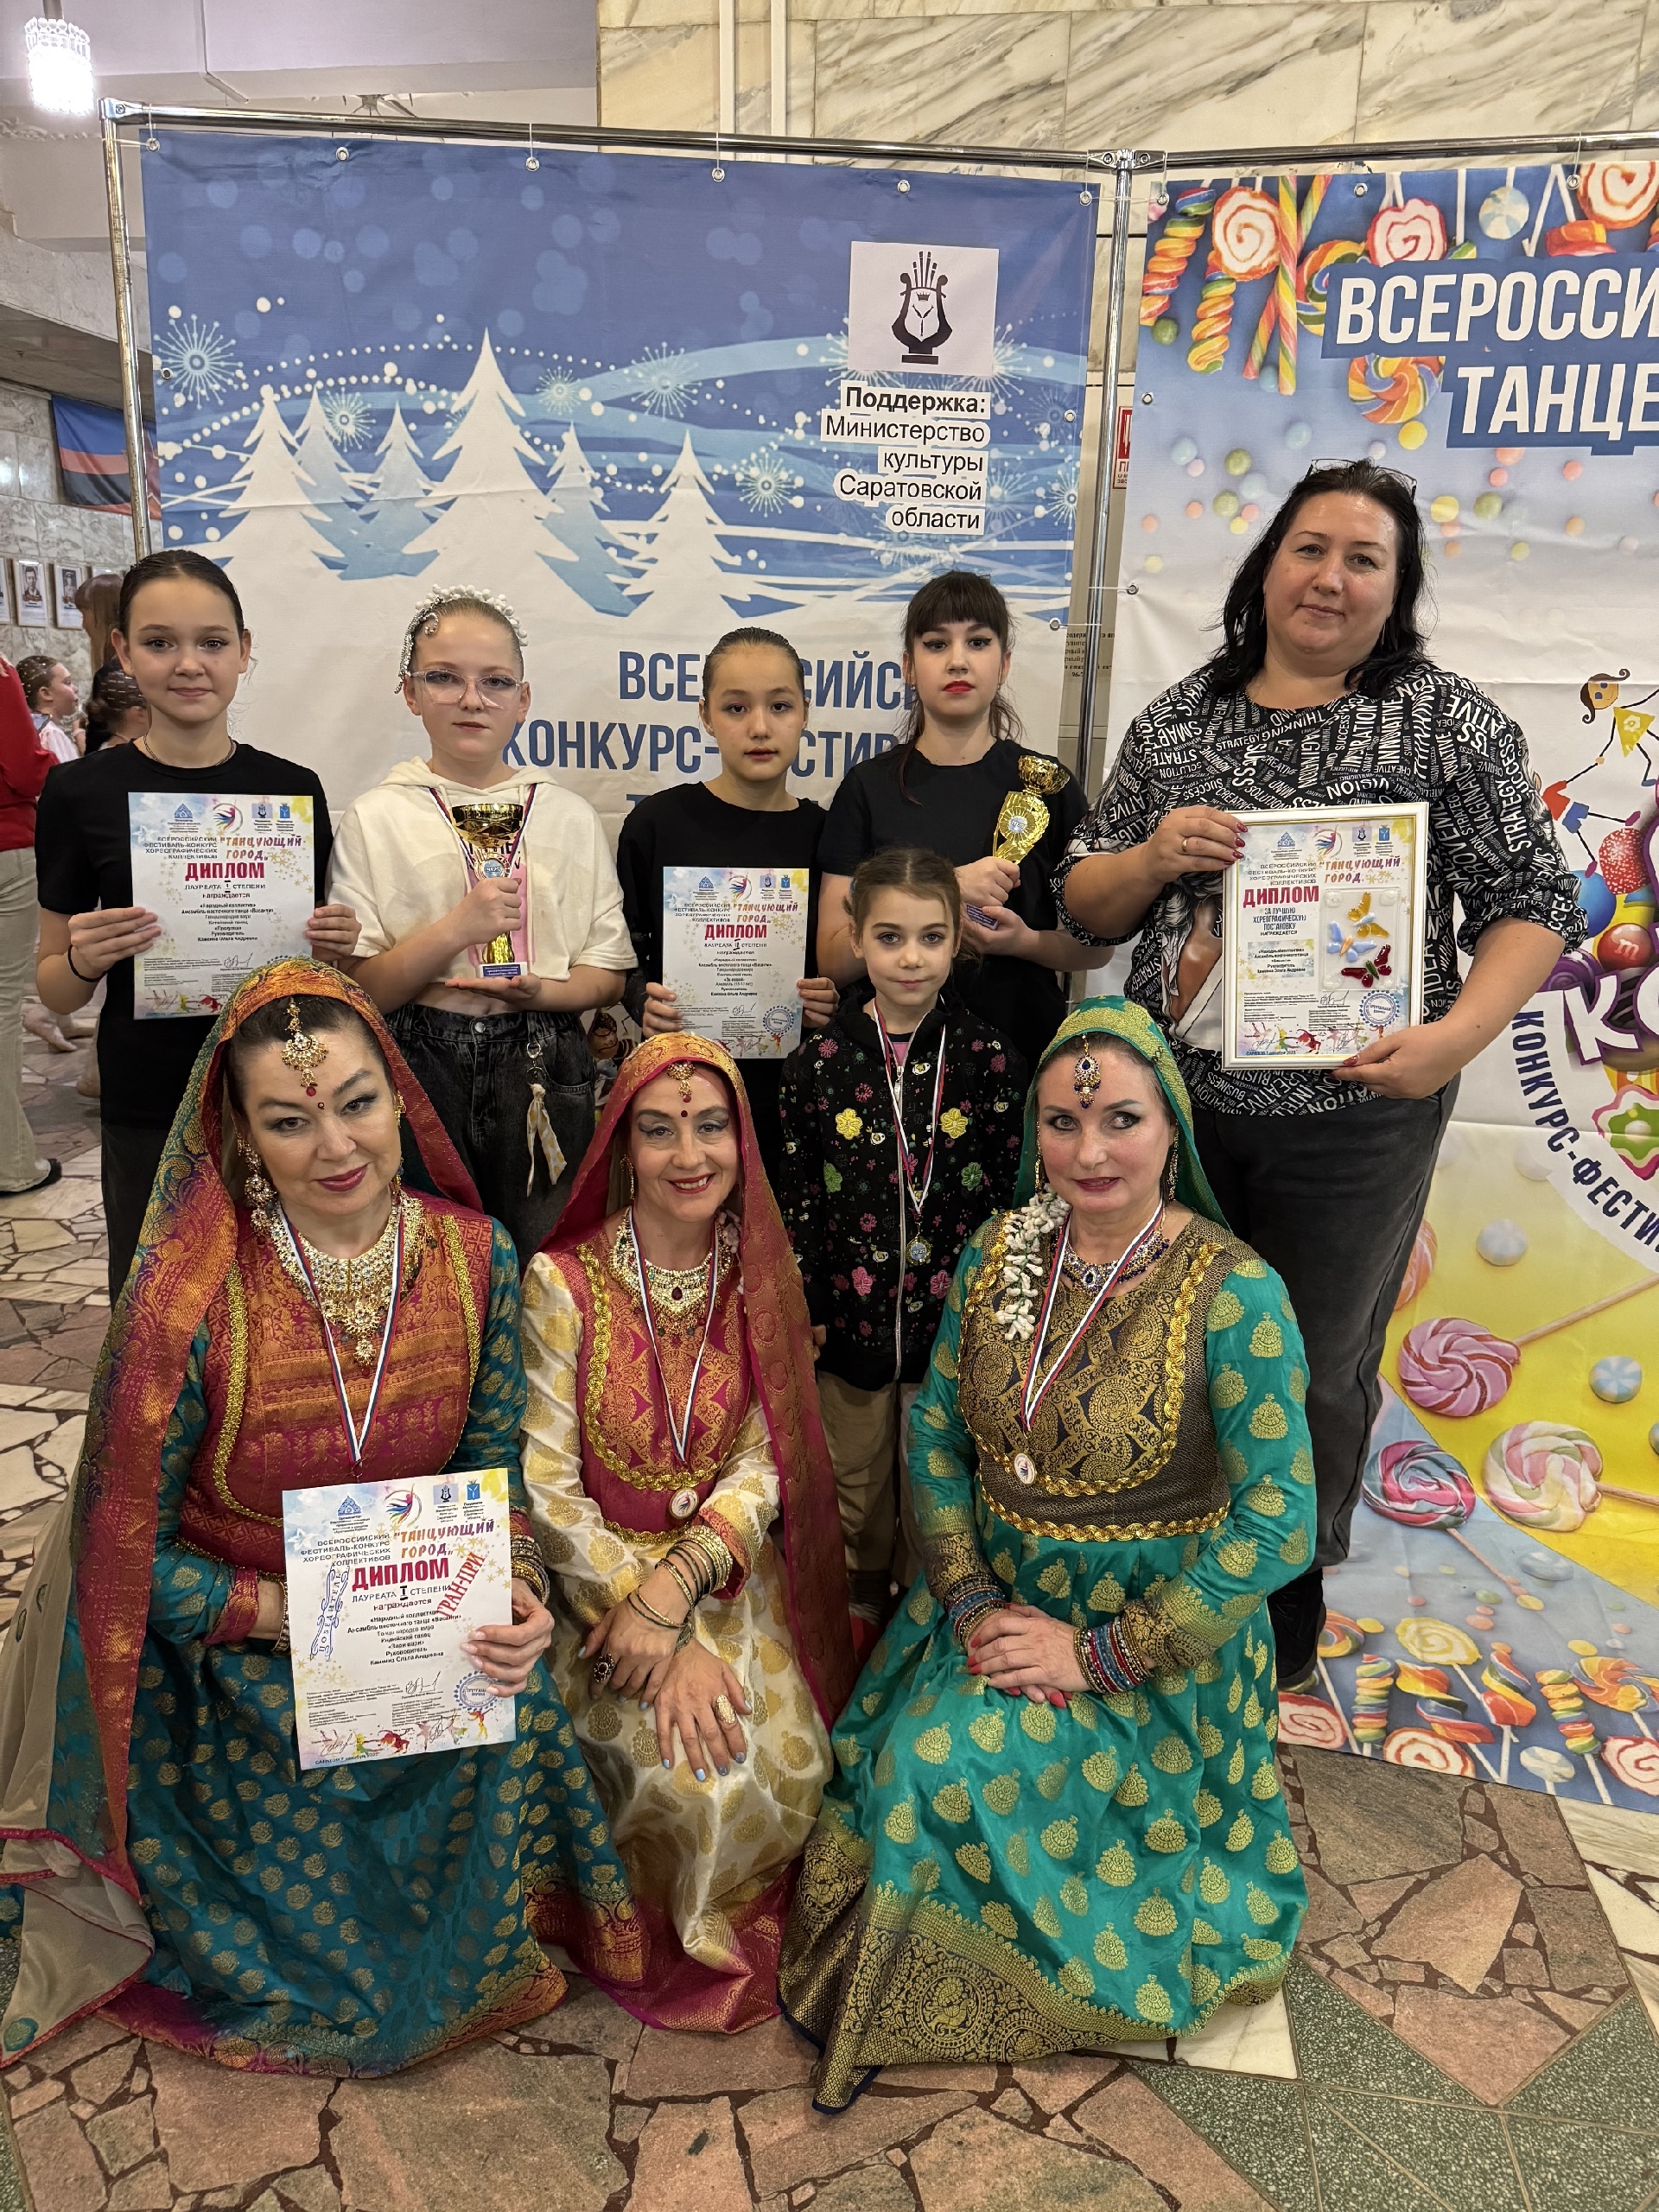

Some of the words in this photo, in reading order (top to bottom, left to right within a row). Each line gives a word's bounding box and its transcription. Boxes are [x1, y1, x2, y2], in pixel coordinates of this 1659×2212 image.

[846, 386, 986, 414] Поддержка:
[826, 415, 985, 445] Министерство
[883, 452, 983, 475] культуры
[839, 474, 982, 501] Саратовской
[892, 508, 980, 530] области
[1262, 710, 1325, 741] THINKING
[1335, 715, 1351, 751] SUCCESS
[1216, 734, 1260, 752] STRATEGY
[1160, 761, 1202, 779] SOLUTION
[1374, 765, 1411, 777] CREATIVE
[1183, 779, 1224, 801] SUCCESS
[1495, 779, 1533, 853] STRATEGY
[185, 862, 264, 881] ДИПЛОМ
[1243, 886, 1319, 907] ДИПЛОМ
[704, 925, 767, 940] ДИПЛОМ
[1206, 1071, 1246, 1101] BUSINESS
[1511, 1011, 1659, 1253] КОНКУРС-ФЕСТИ
[301, 1541, 390, 1554] ФЕСТИВАЛЬ-КОНКУРС
[303, 1548, 391, 1562] ХОРЕОГРАФИЧЕСКИХ
[332, 1555, 391, 1566] КОЛЛЕКТИВОВ
[352, 1558, 448, 1592] ДИПЛОМ
[353, 1591, 397, 1603] ЛАУРЕАТА
[410, 1585, 451, 1595] СТЕПЕНИ
[373, 1599, 432, 1611] награждается
